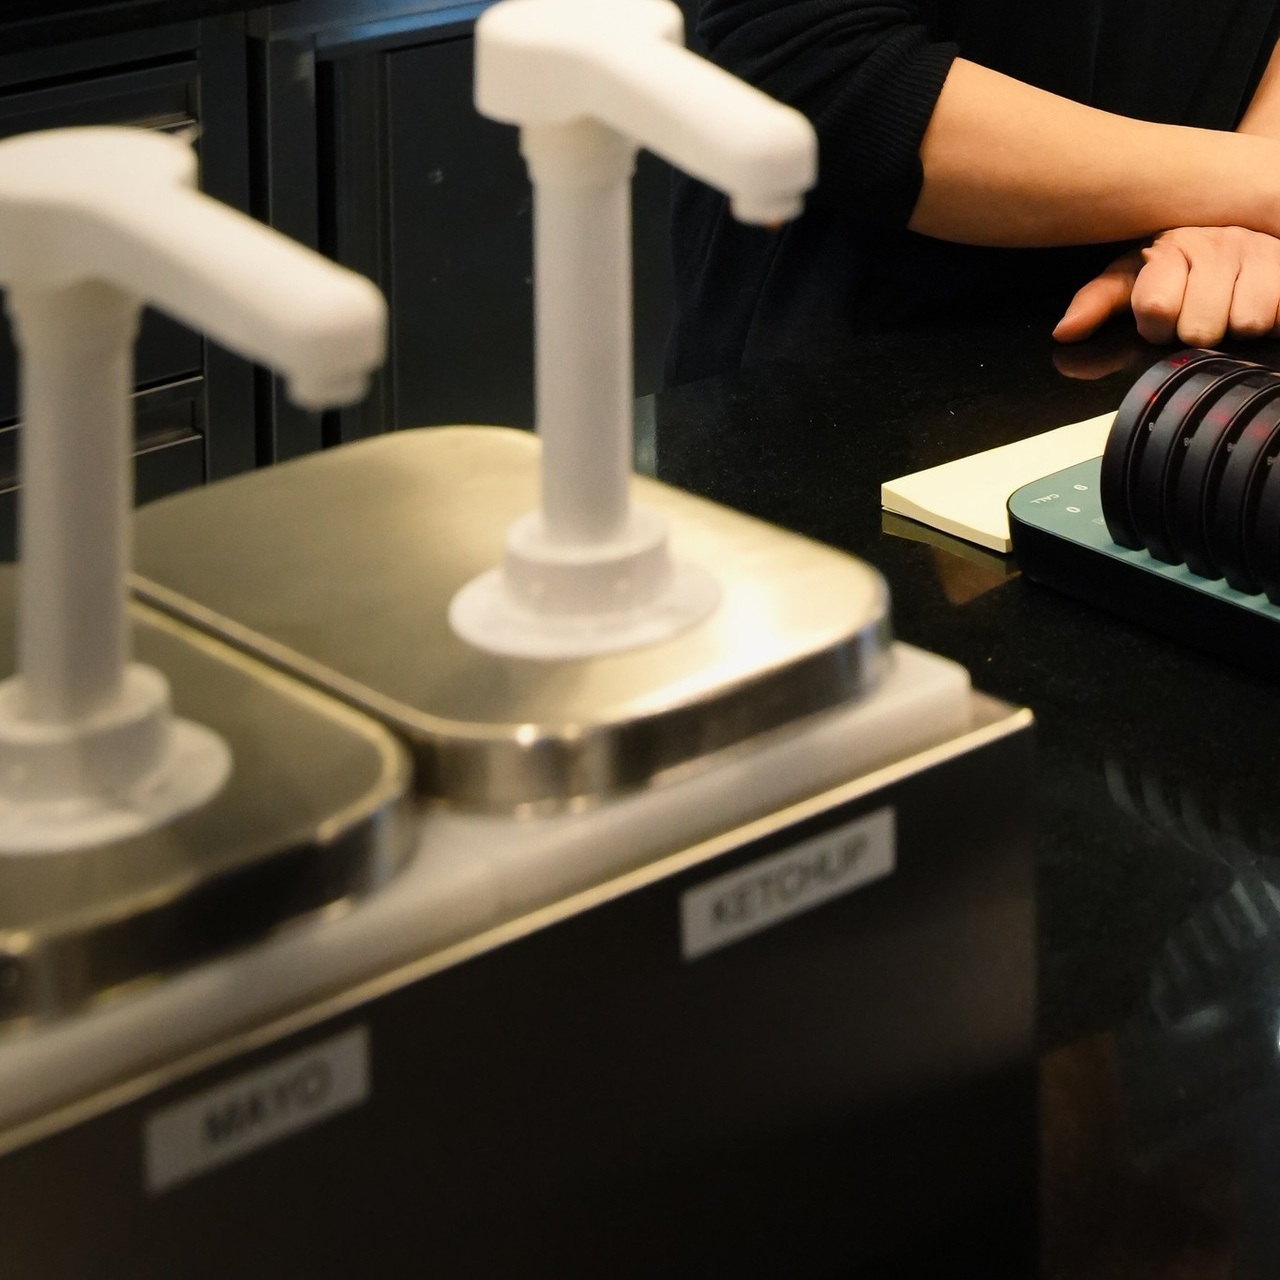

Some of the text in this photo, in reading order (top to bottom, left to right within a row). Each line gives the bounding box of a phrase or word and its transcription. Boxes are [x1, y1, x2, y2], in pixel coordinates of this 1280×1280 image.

[1029, 493, 1060, 505] CALL
[711, 832, 871, 928] KETCHUP
[204, 1058, 333, 1144] MAYO
